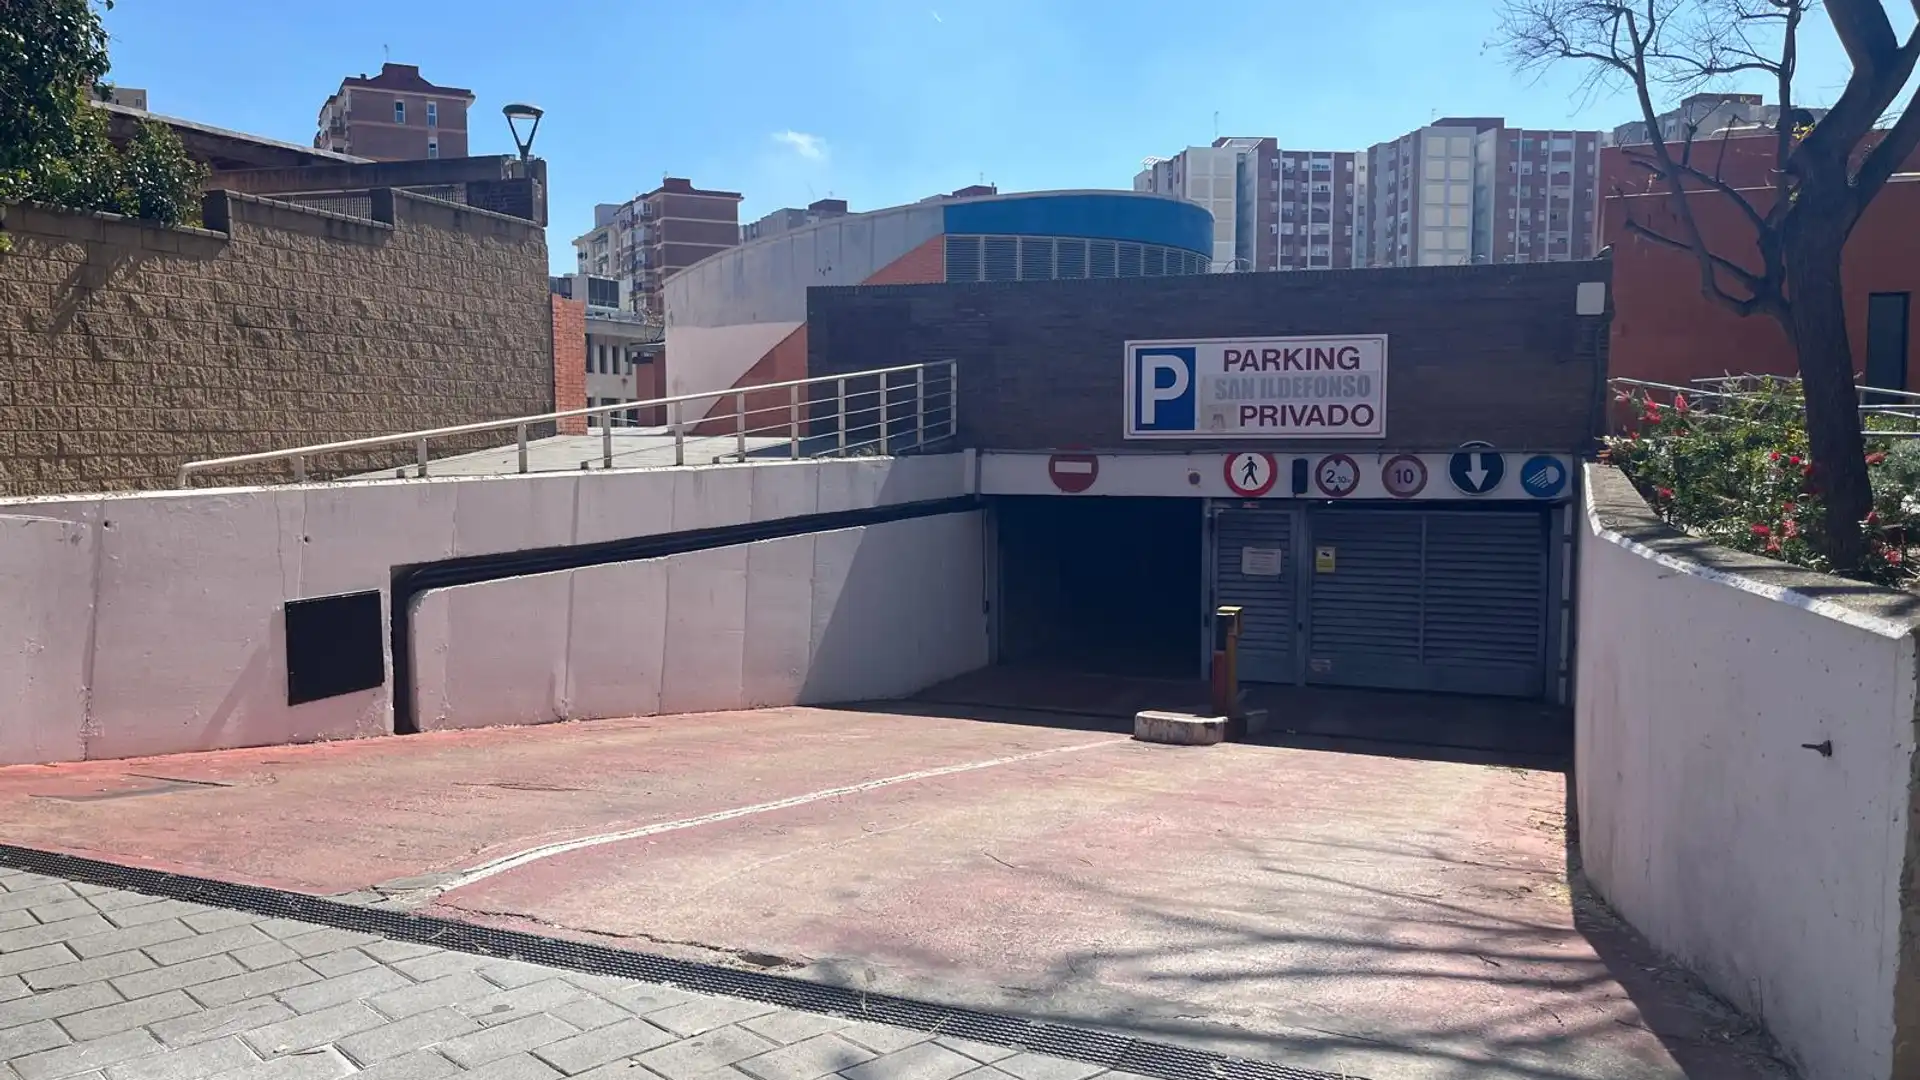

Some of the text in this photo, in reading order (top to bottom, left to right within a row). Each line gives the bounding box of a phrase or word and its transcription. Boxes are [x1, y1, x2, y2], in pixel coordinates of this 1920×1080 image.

[1223, 346, 1361, 372] PARKING
[1141, 354, 1190, 425] P
[1214, 374, 1371, 400] SAN ILDEFONSO
[1239, 404, 1374, 427] PRIVADO
[1395, 468, 1414, 484] 10
